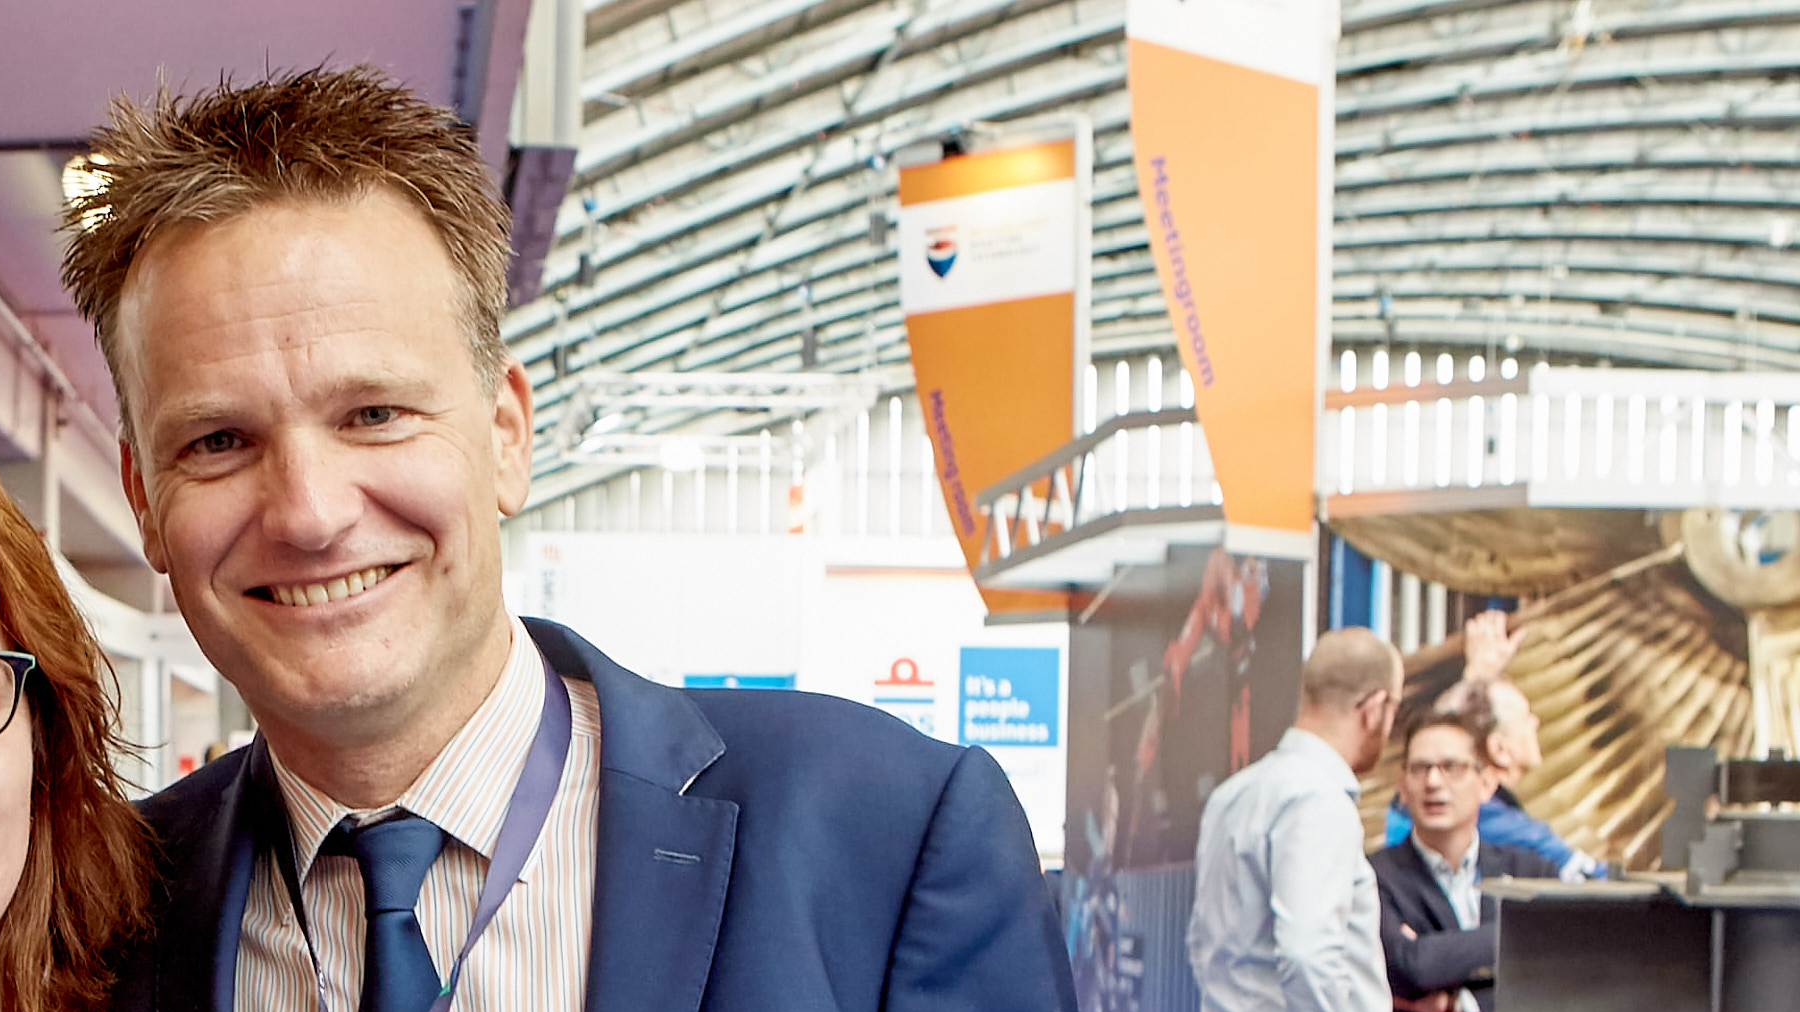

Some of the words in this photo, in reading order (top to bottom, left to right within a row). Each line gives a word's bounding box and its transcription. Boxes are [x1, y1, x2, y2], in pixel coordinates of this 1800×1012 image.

[1149, 156, 1215, 389] Meetingroom
[964, 697, 1030, 723] people
[964, 721, 1049, 742] business
